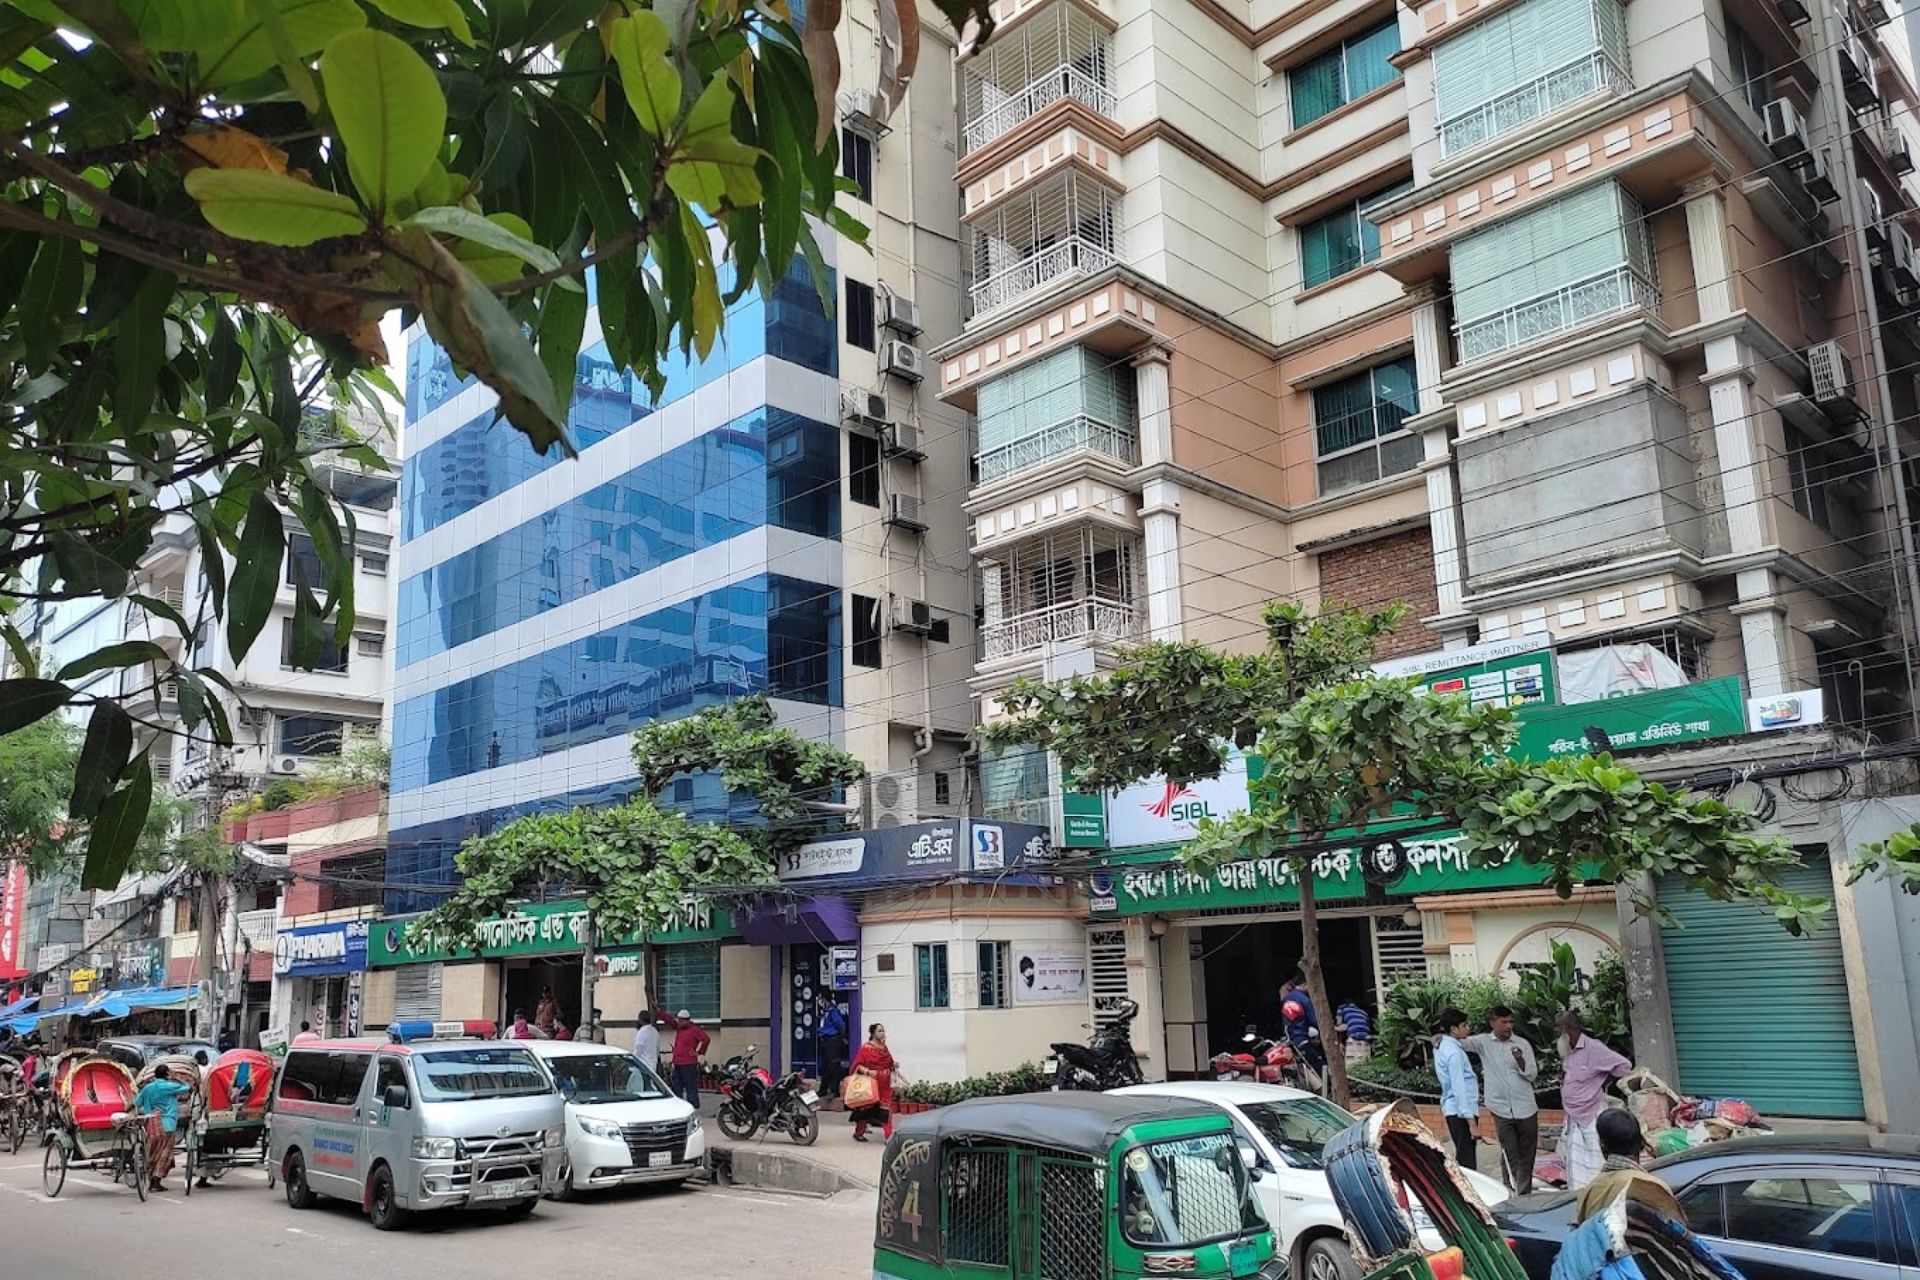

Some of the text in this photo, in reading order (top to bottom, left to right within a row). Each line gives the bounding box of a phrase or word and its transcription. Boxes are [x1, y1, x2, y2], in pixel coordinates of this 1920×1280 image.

[1425, 650, 1488, 670] REMITTANCE
[1490, 641, 1539, 657] PARTNER
[1171, 800, 1217, 821] SIBL
[907, 834, 953, 858] এটিএম
[291, 931, 346, 959] PHARMA
[1152, 1133, 1234, 1158] OBHAI OBHAI
[901, 1180, 922, 1242] 4
